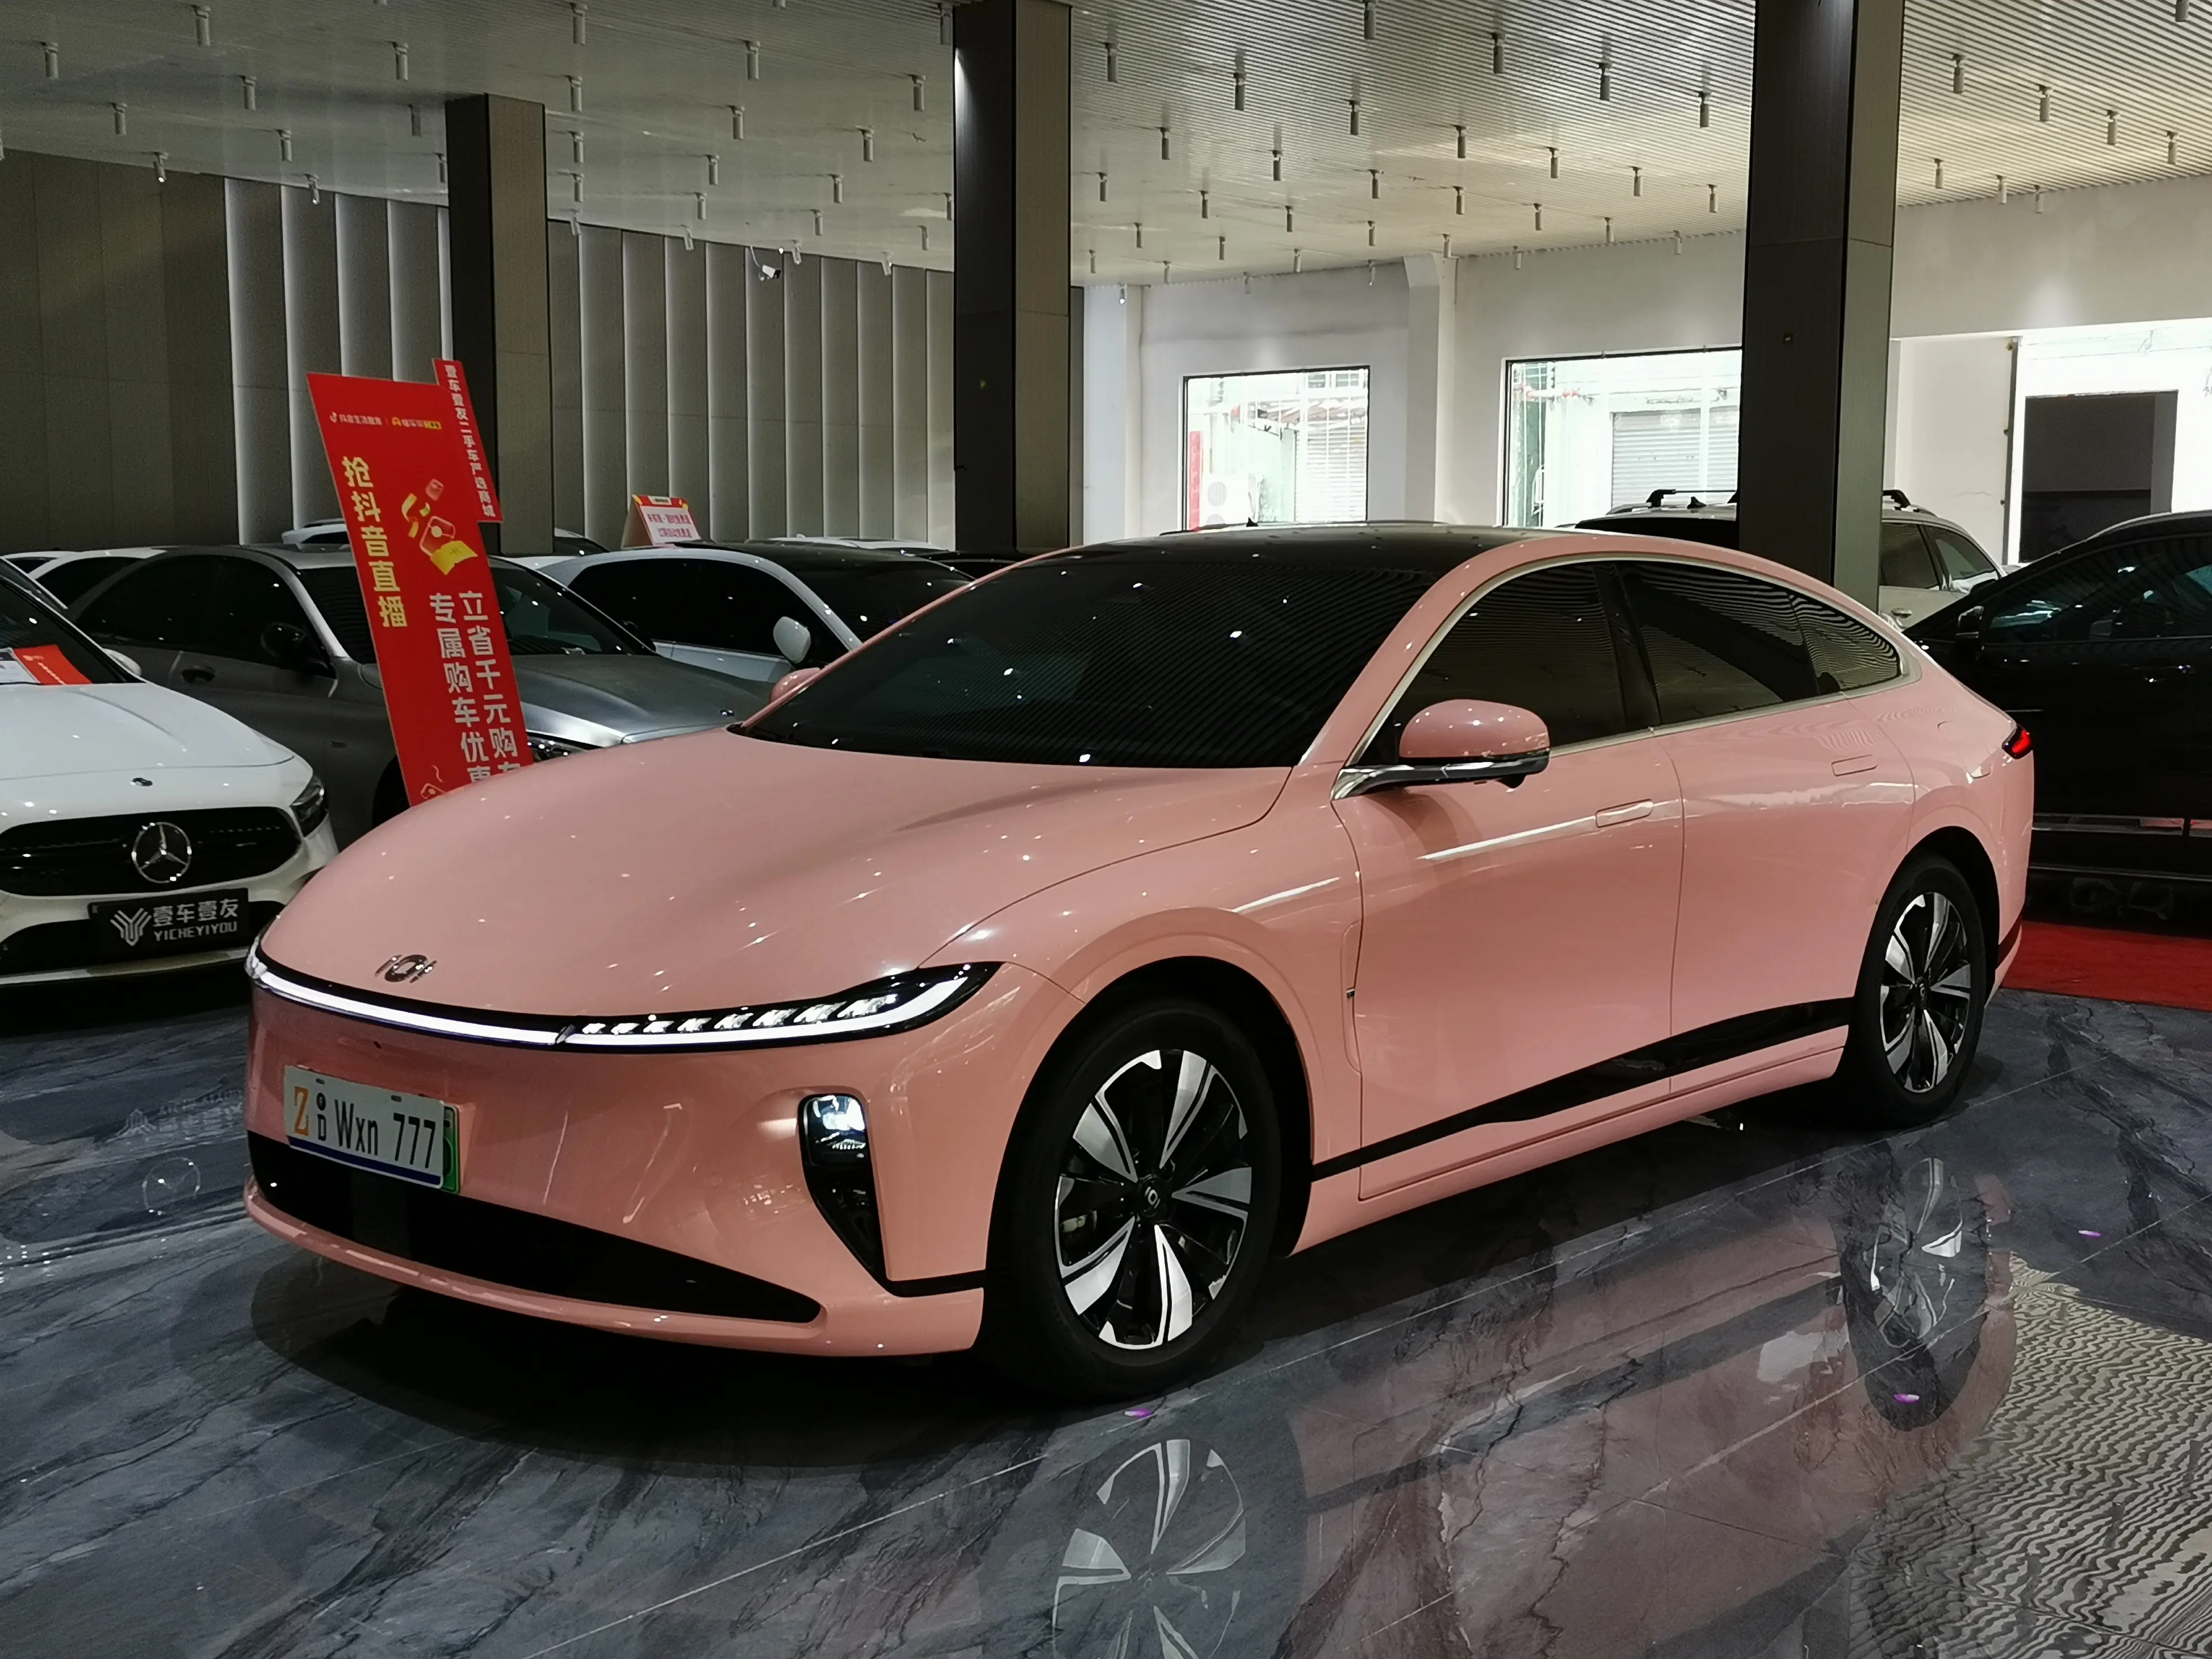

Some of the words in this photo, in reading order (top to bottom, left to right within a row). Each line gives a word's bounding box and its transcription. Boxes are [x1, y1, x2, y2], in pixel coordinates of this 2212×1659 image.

[342, 456, 408, 627] 抢抖音直播
[153, 899, 238, 927] 壹车壹友
[153, 921, 237, 941] YICHEYIYOU
[335, 1099, 378, 1156] Wxn
[393, 1113, 436, 1168] 777
